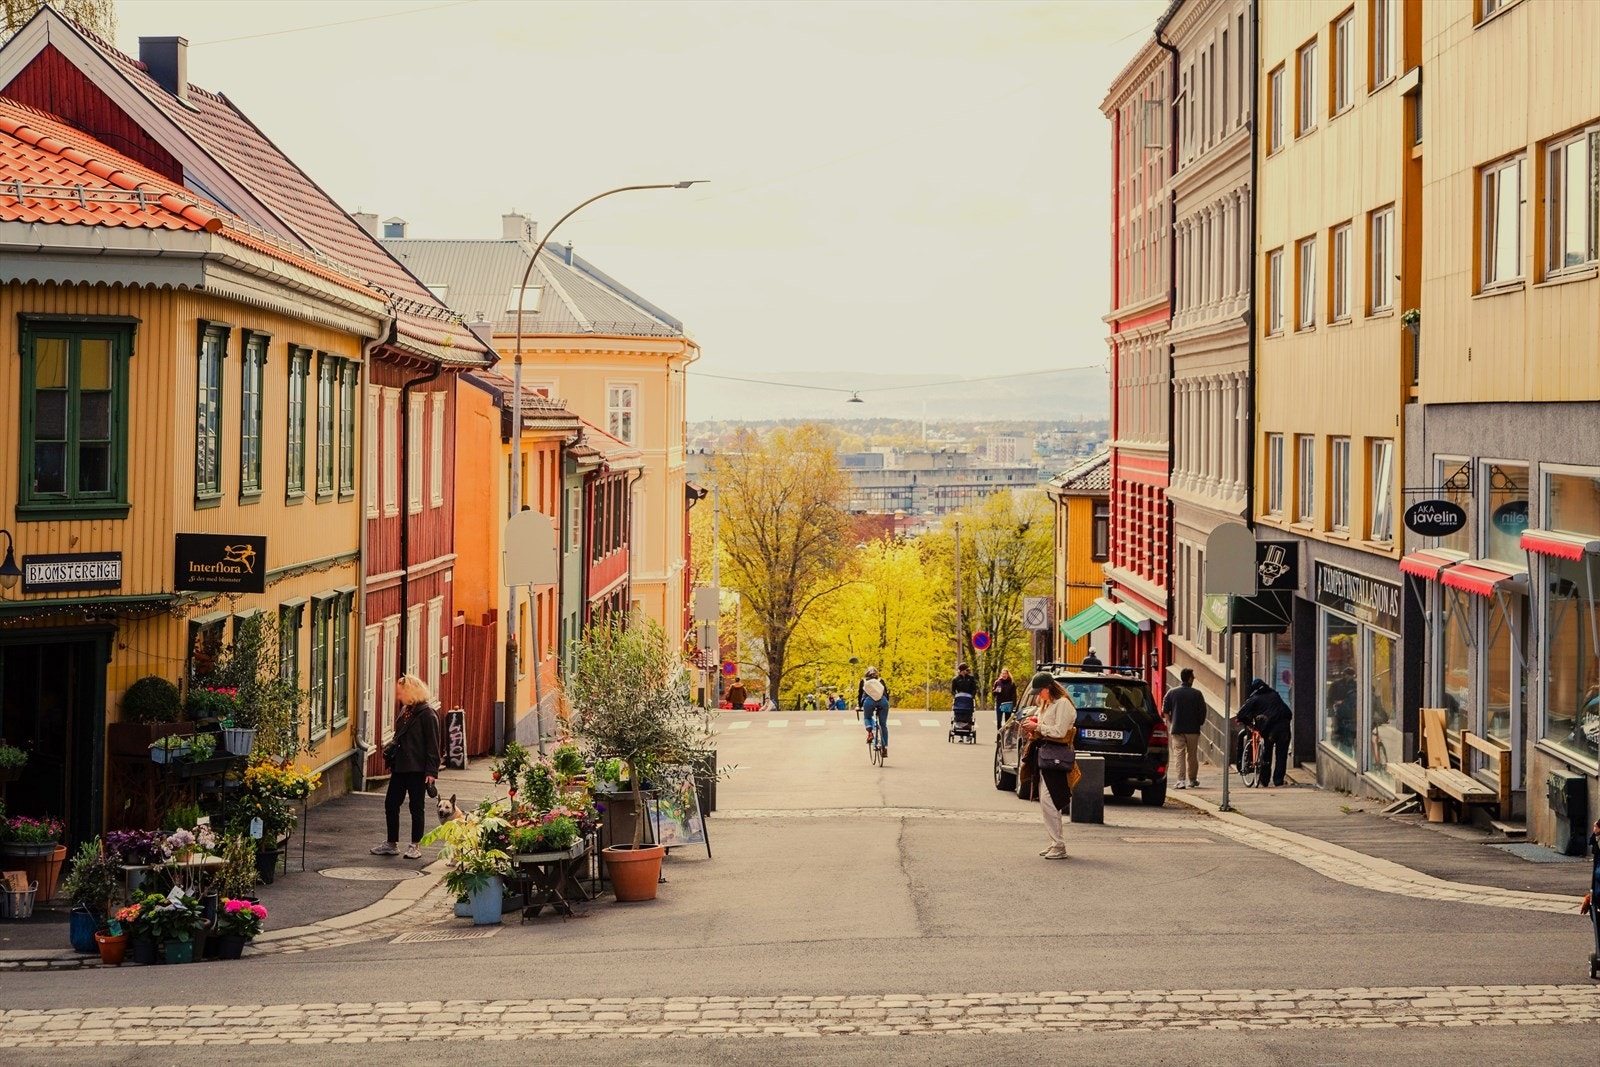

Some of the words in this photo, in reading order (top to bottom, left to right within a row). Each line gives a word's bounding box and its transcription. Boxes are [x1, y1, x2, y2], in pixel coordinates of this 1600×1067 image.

[1418, 505, 1435, 513] AKA
[1413, 511, 1457, 525] javelin
[30, 564, 117, 581] BLOMSTERENGA
[189, 561, 241, 573] Interflora
[1346, 574, 1389, 616] INSTALLASJON
[1389, 588, 1399, 618] AS
